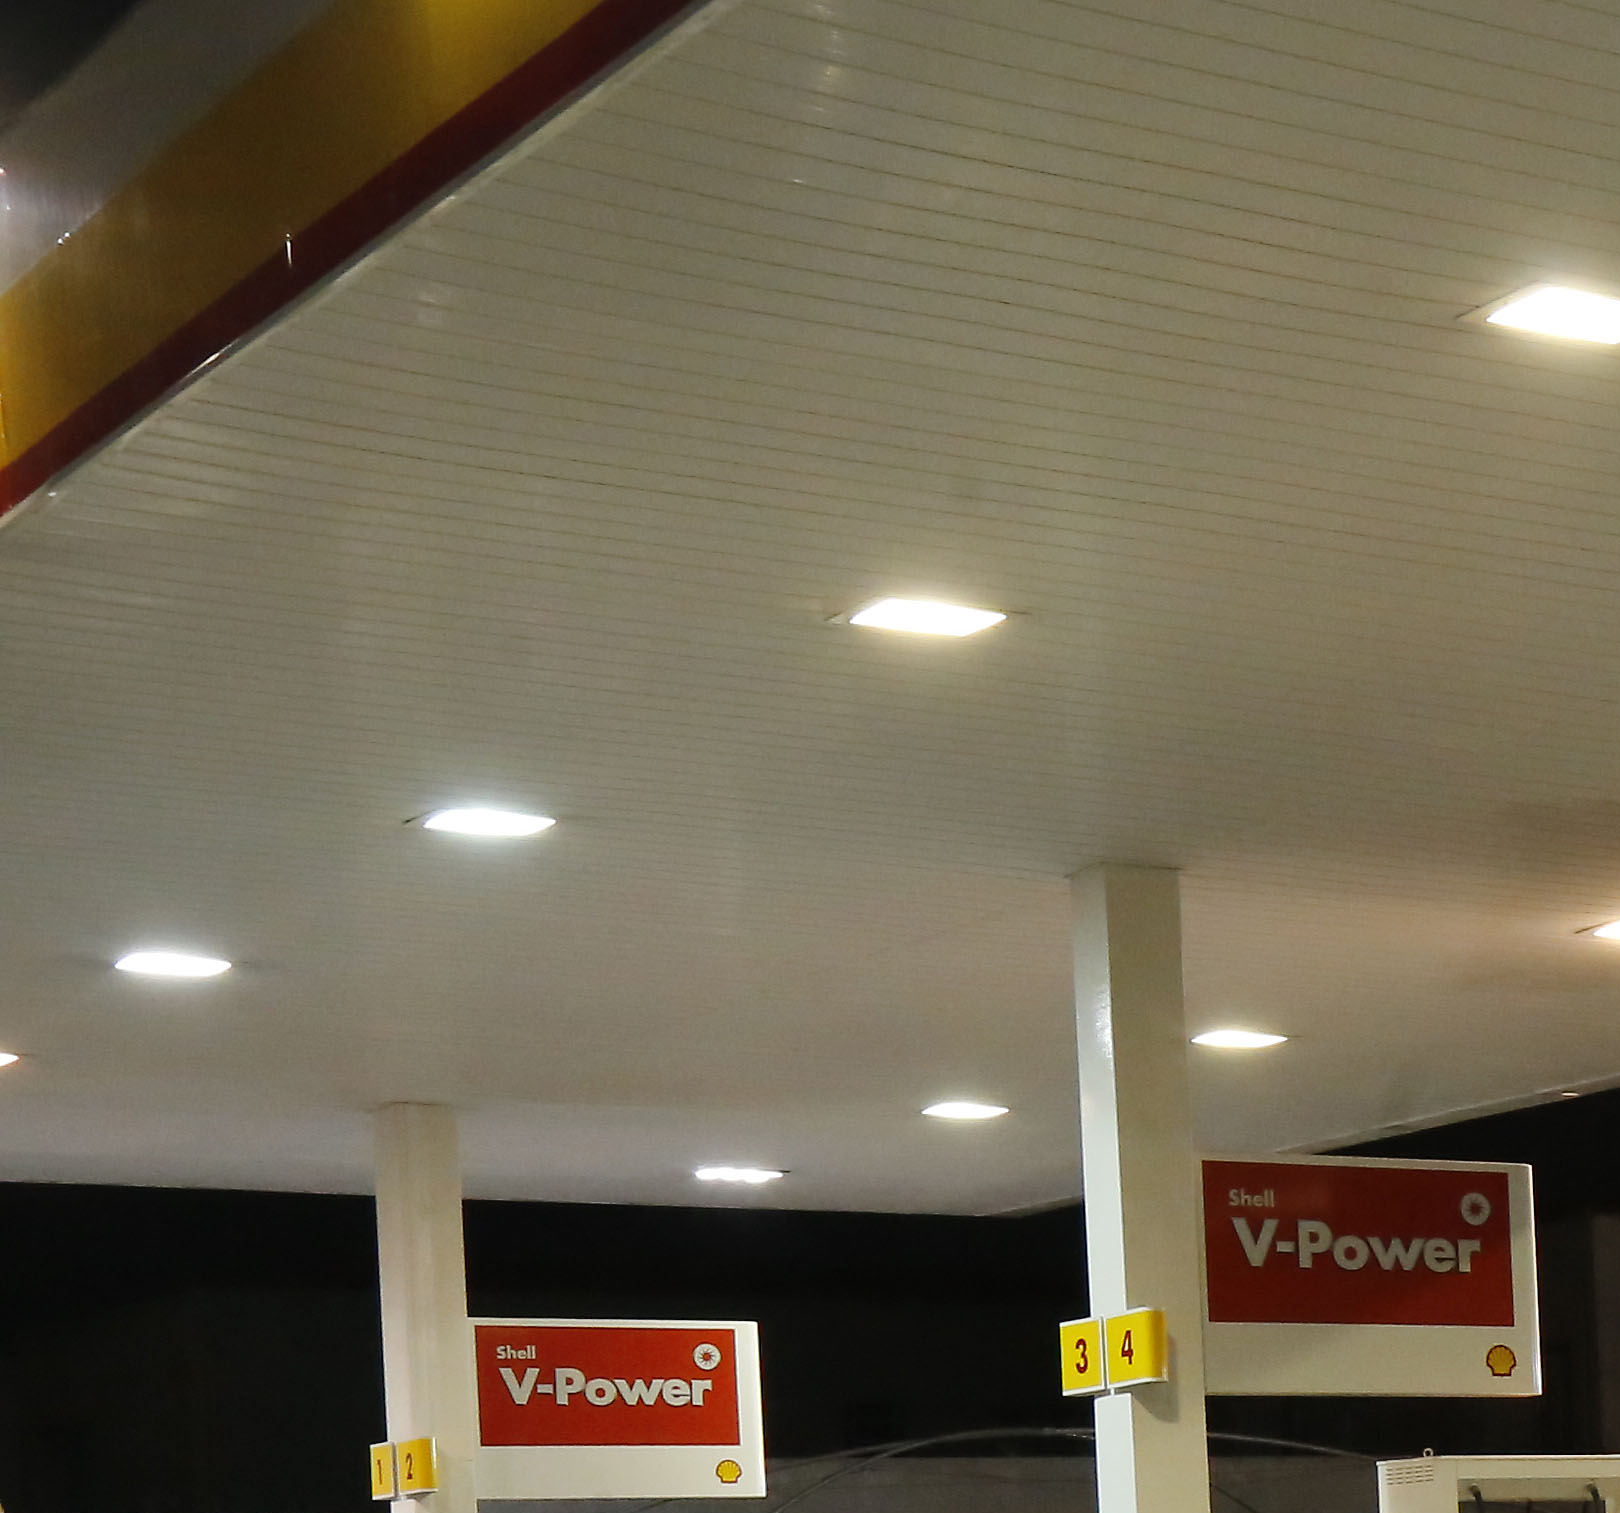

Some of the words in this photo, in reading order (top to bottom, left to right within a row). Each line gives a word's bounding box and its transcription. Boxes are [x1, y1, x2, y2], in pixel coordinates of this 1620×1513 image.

[1228, 1188, 1275, 1208] Shell
[1231, 1217, 1481, 1272] V-Power
[496, 1345, 536, 1360] Shell
[1075, 1338, 1088, 1374] 3
[1121, 1329, 1133, 1365] 4
[499, 1367, 712, 1406] V-Power
[376, 1459, 383, 1484] 1
[406, 1452, 413, 1480] 2
